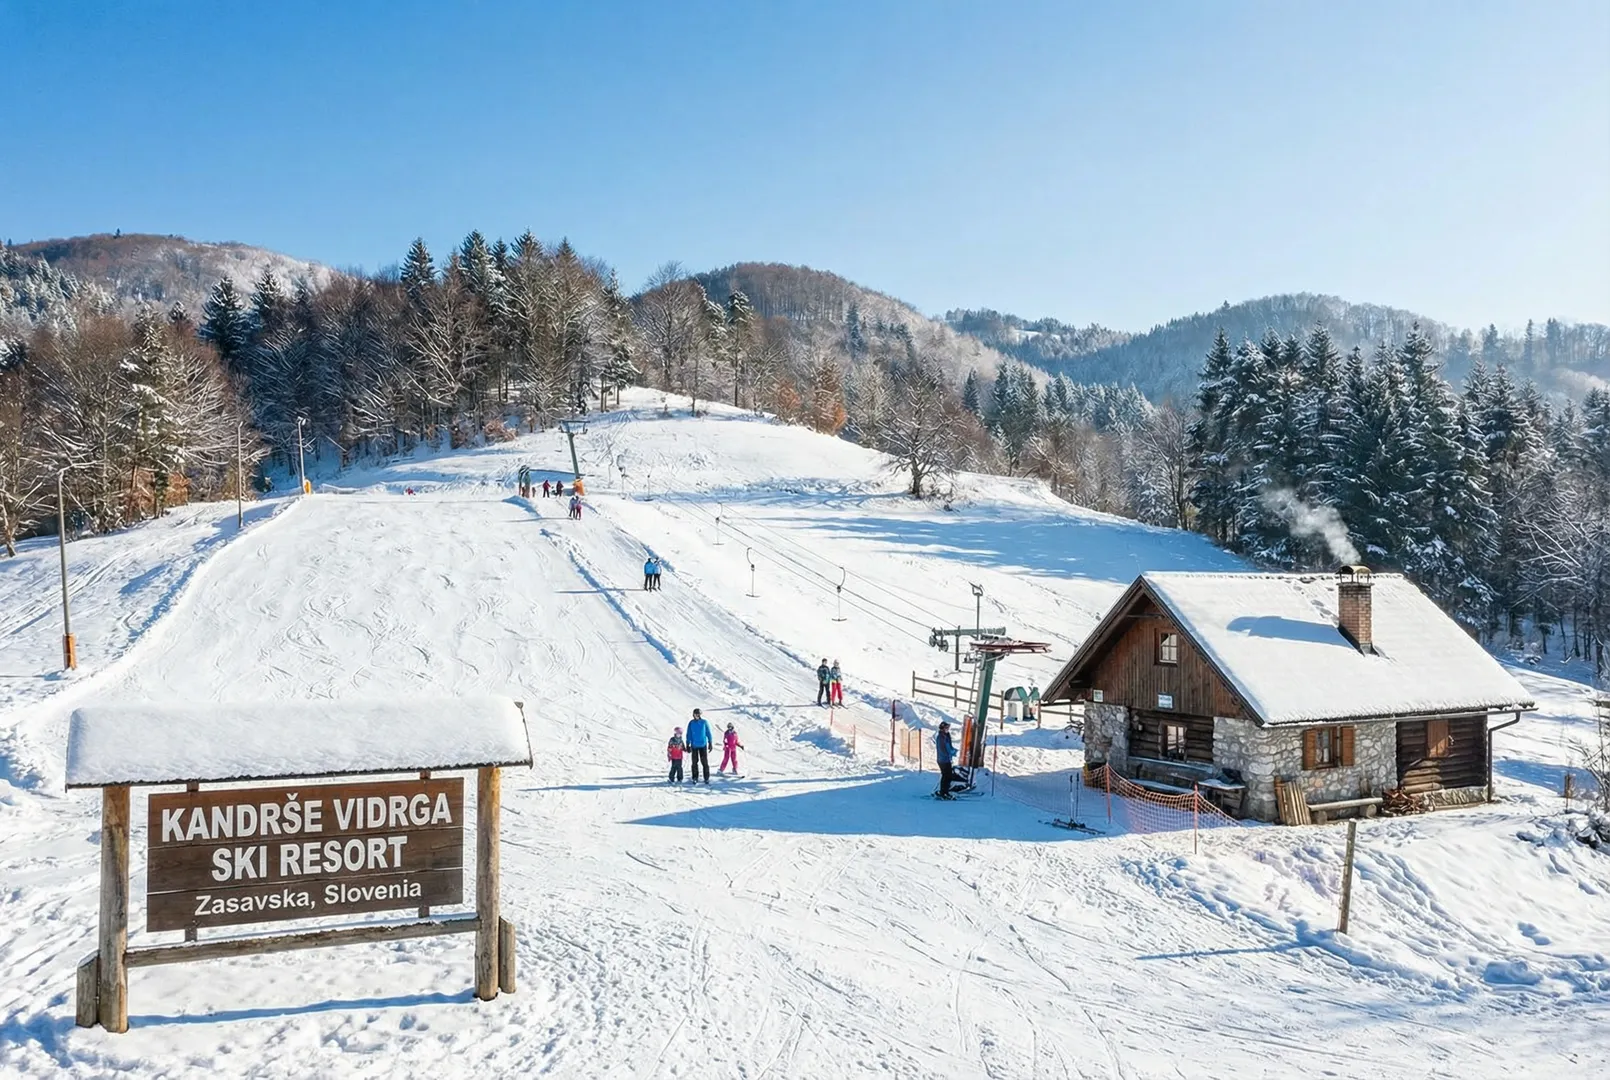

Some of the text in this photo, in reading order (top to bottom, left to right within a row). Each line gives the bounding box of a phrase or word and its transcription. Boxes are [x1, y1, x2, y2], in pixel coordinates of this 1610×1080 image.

[161, 792, 453, 842] KANDRŠE VIDRGA
[211, 836, 408, 882] SKI RESORT
[194, 879, 422, 916] Zasavska, Slovenia
